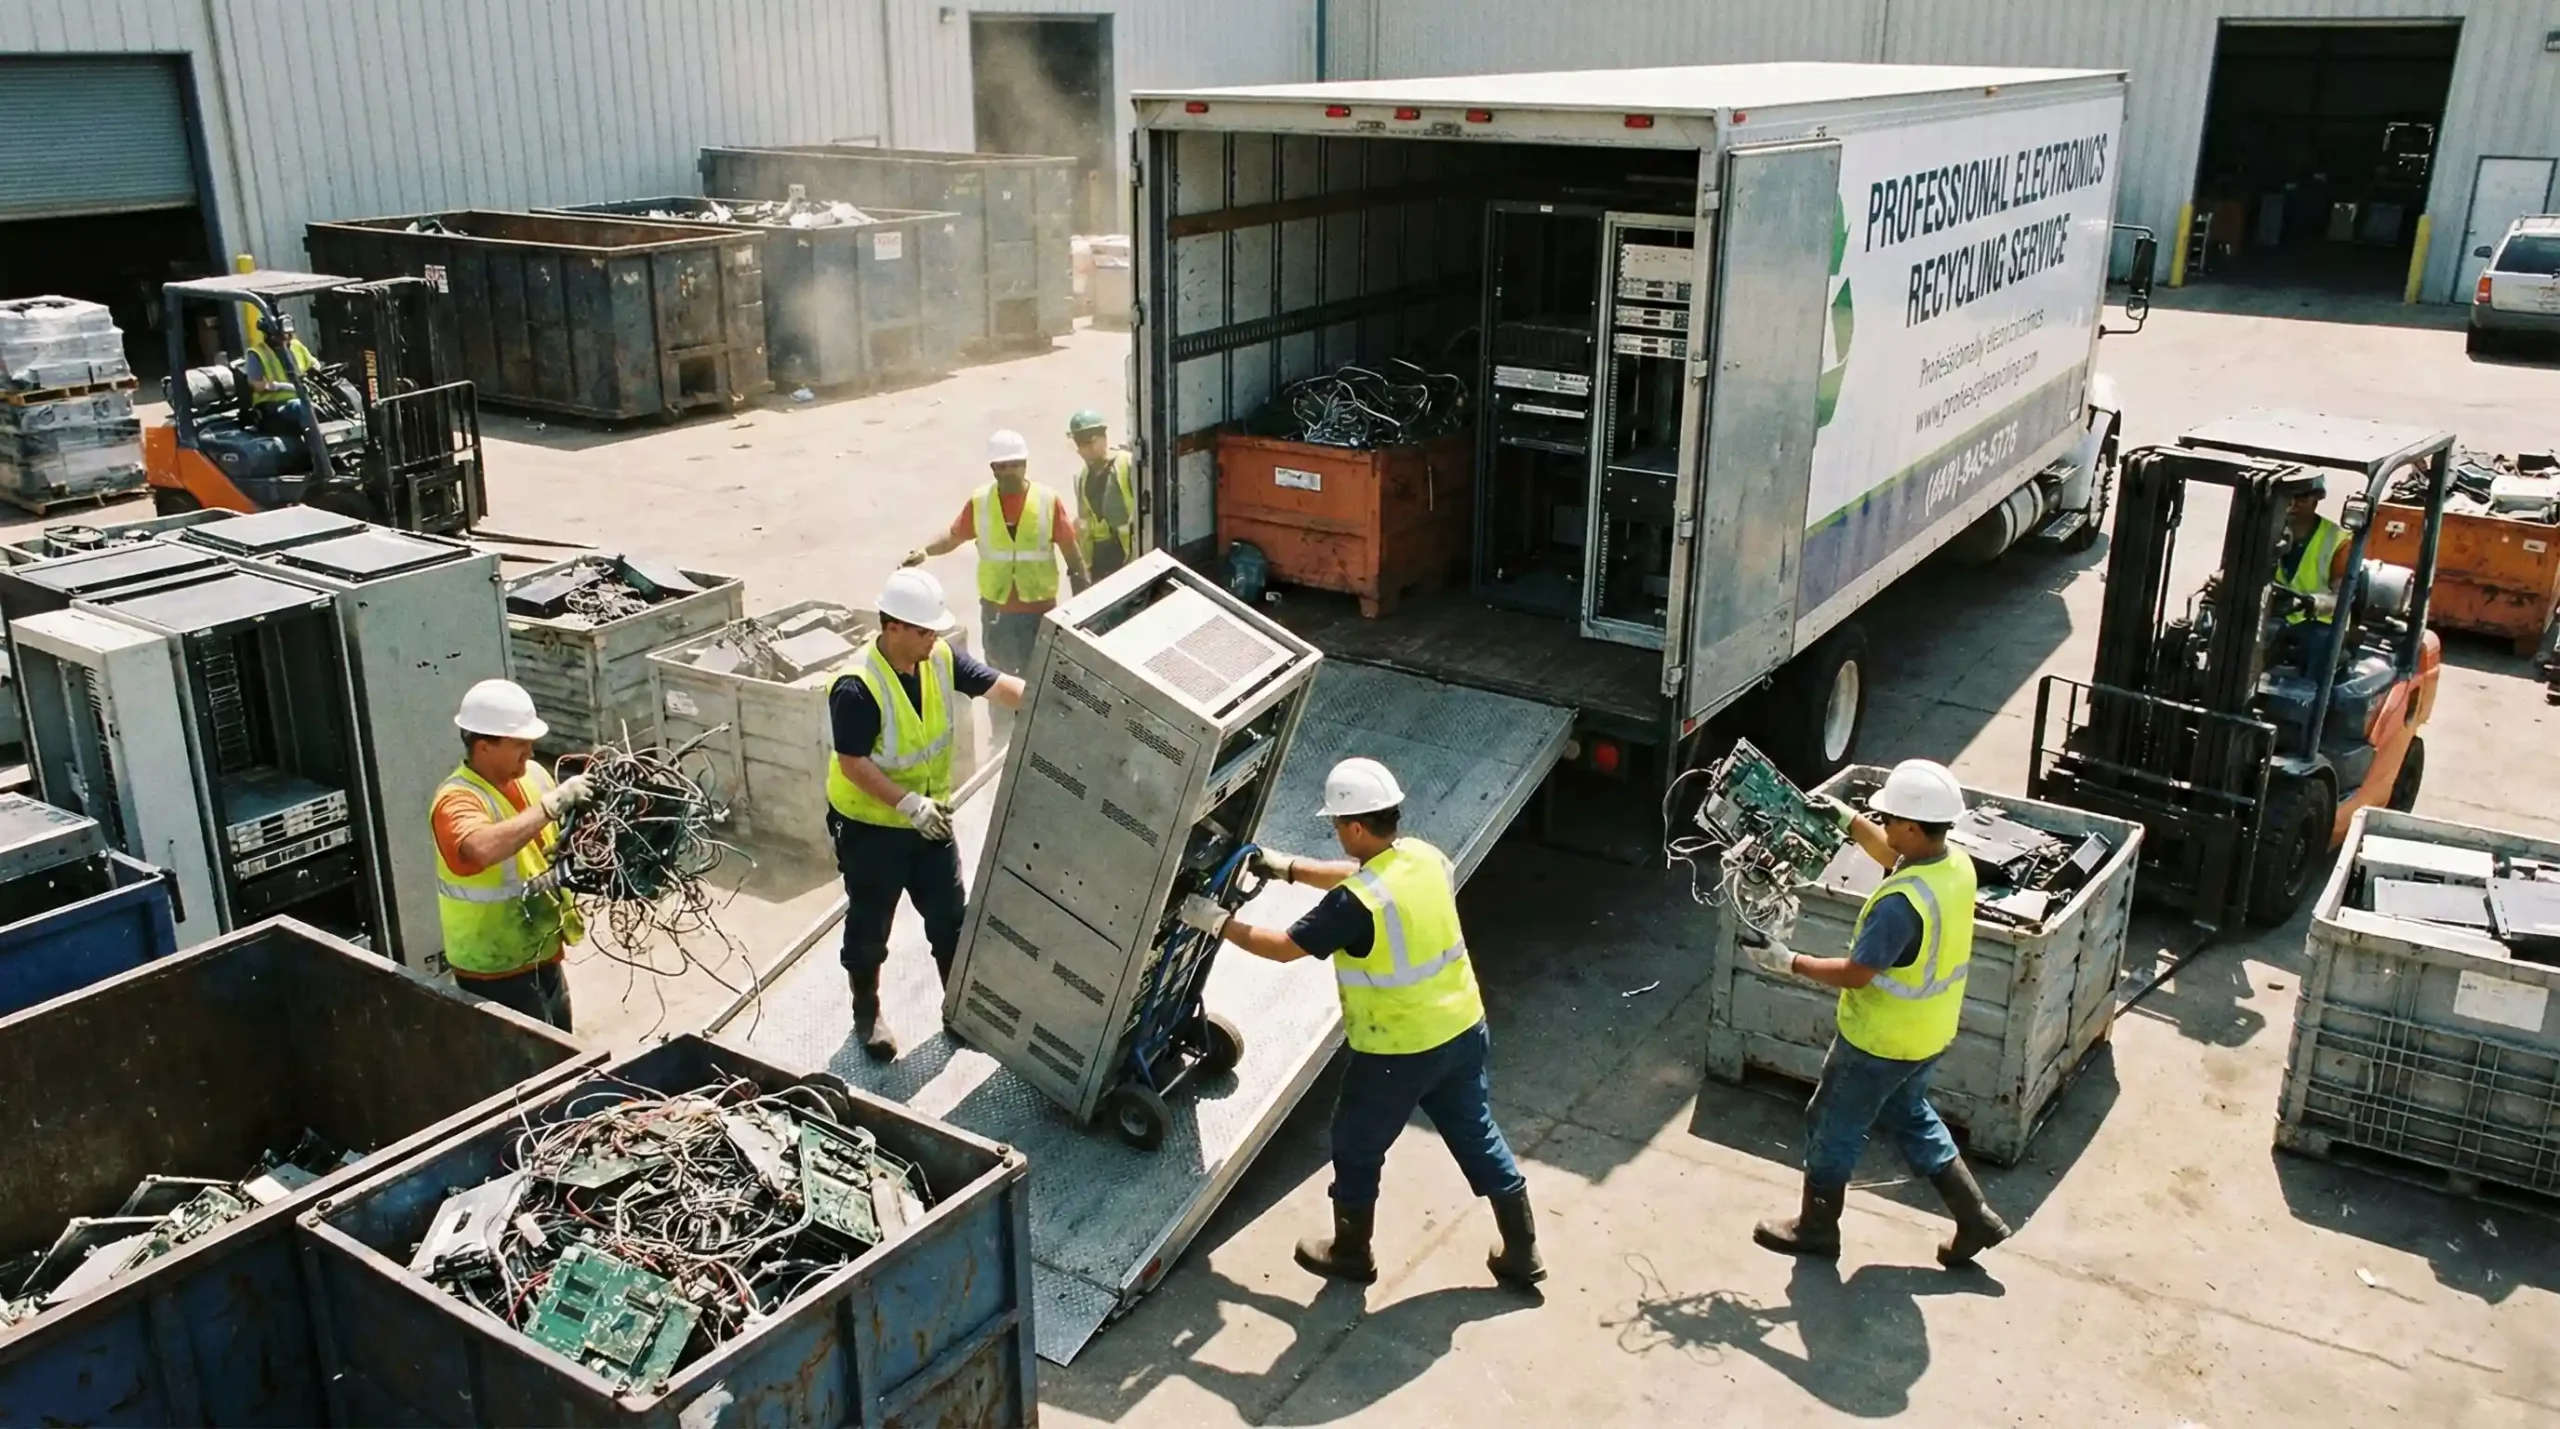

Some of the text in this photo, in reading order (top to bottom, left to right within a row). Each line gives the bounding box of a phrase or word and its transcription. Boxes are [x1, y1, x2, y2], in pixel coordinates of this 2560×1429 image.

[1866, 133, 2107, 252] PROFESSIONAL ELECTRONICS
[1906, 212, 2070, 328] RECYCLING SERVICE
